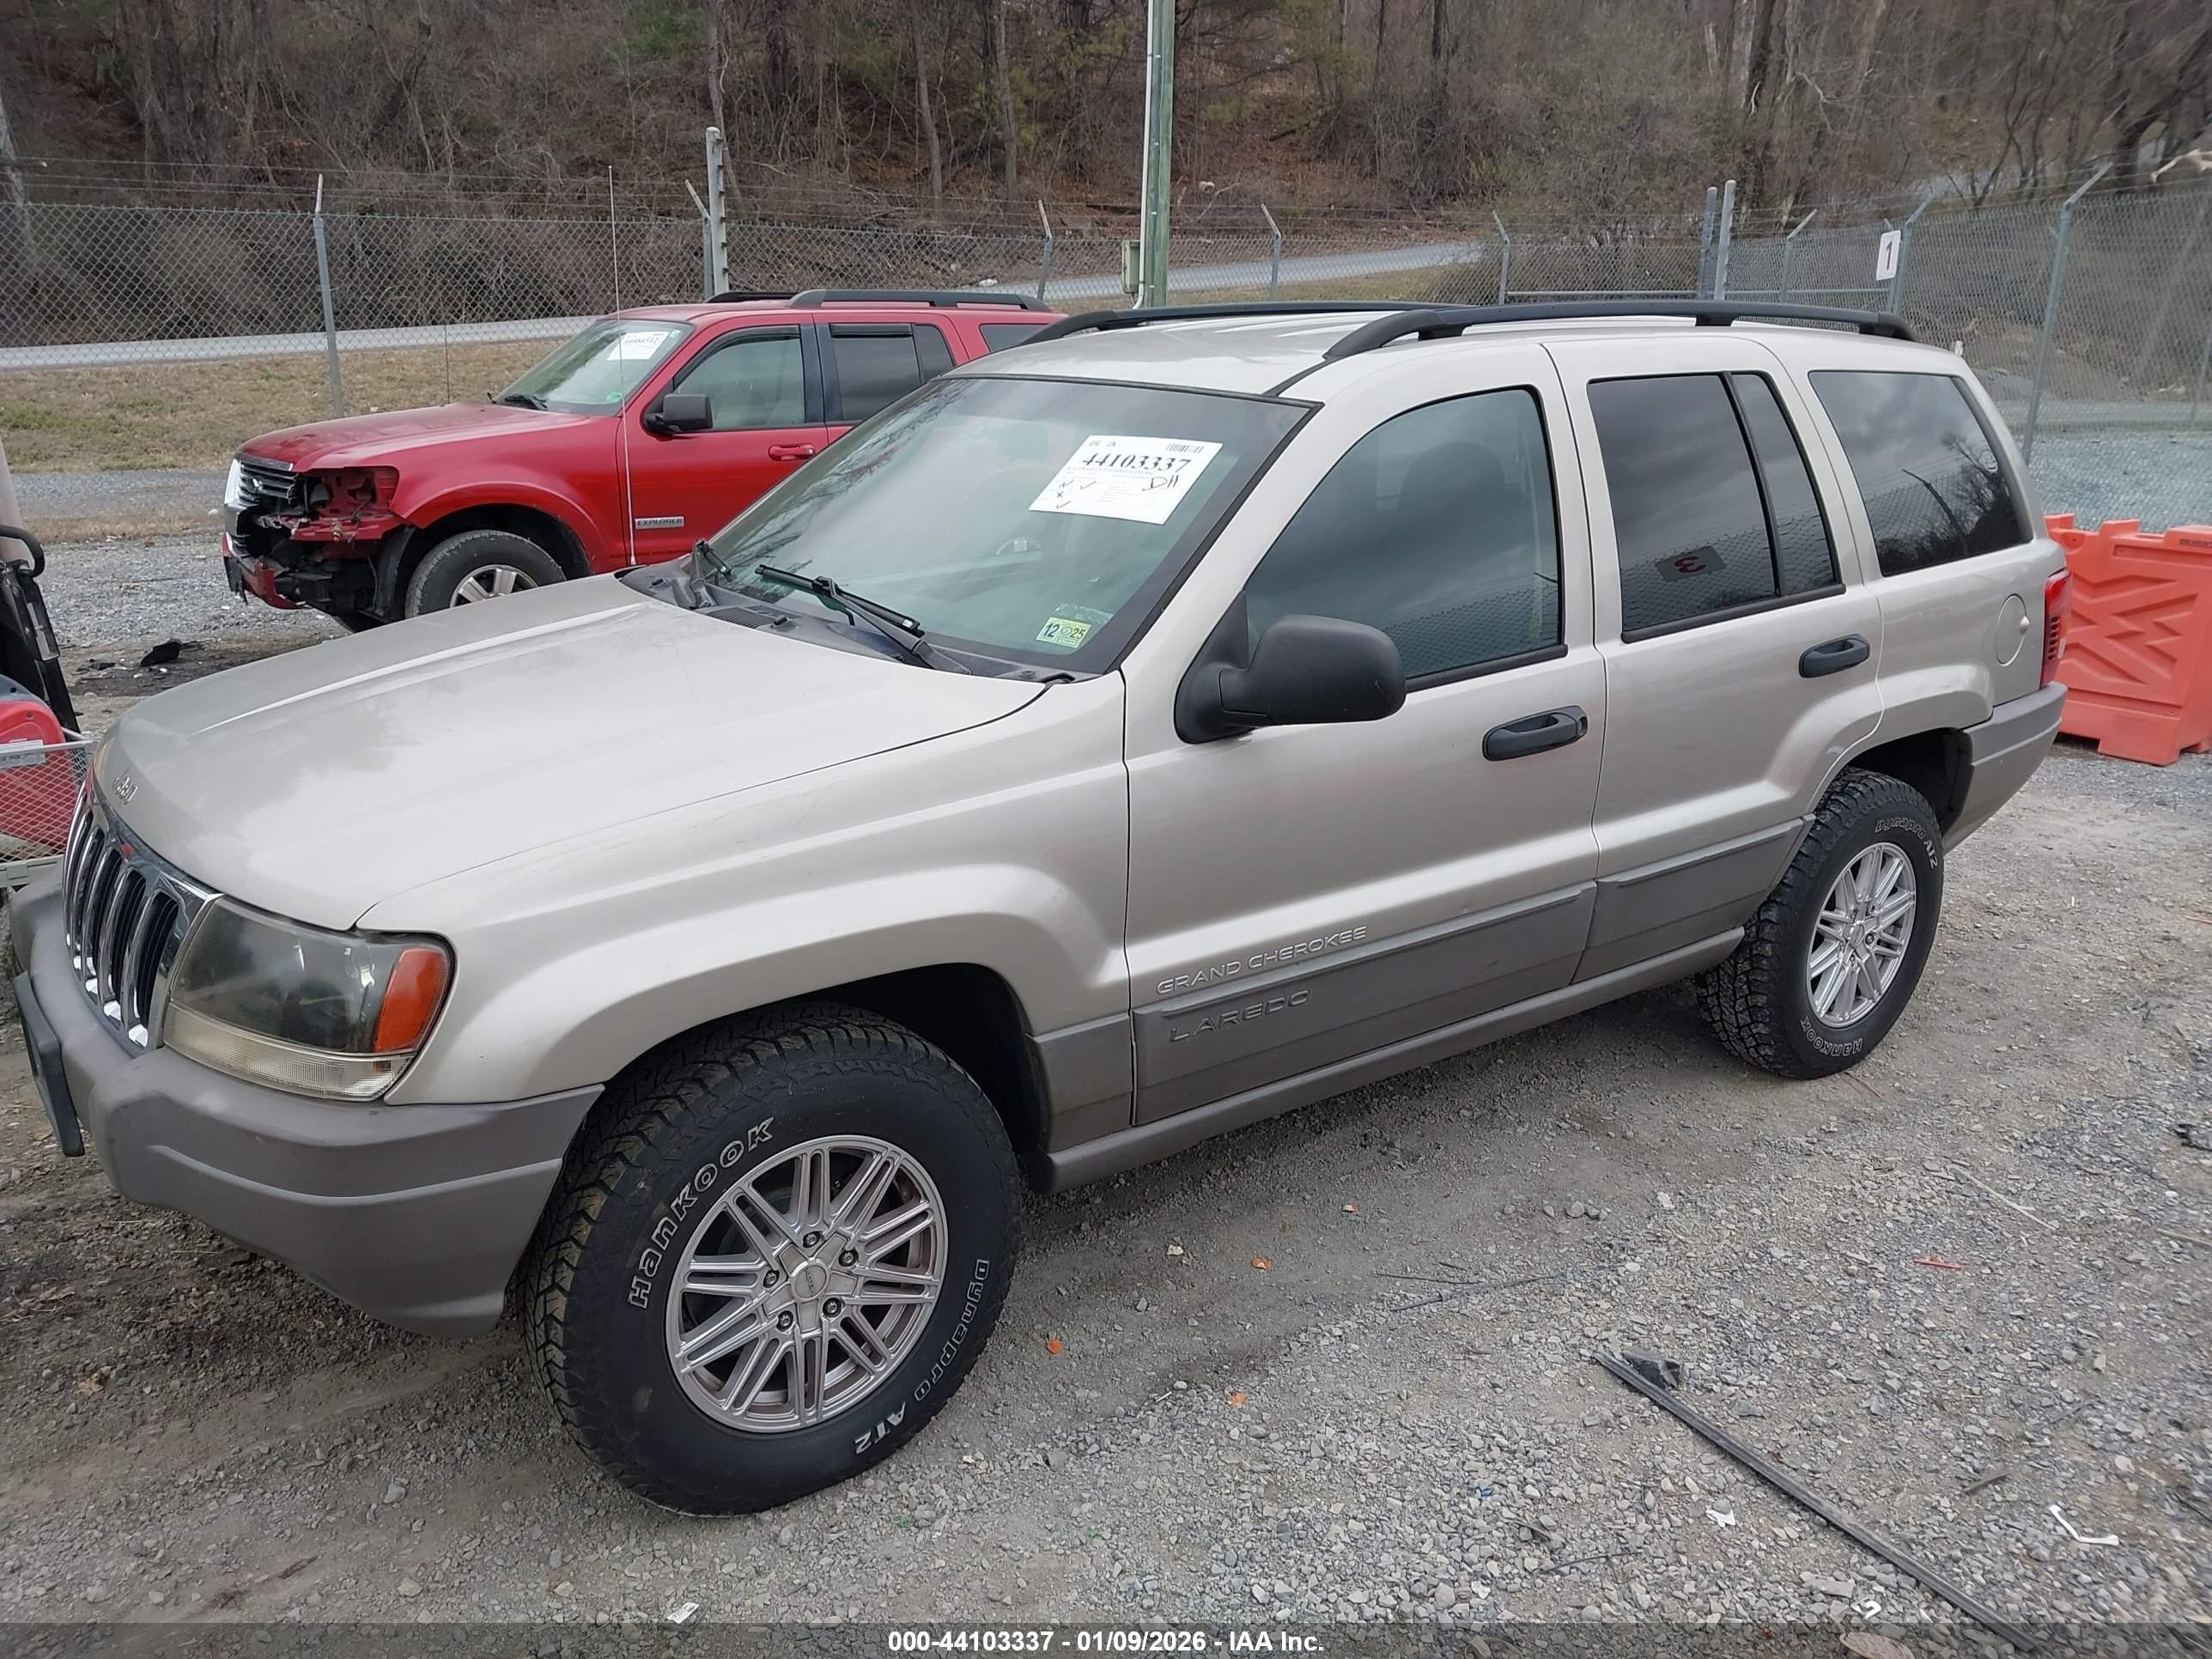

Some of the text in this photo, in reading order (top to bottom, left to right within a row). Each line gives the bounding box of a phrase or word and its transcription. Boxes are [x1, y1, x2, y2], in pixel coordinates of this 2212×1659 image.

[1886, 240, 1893, 270] 1
[1082, 453, 1192, 472] 44103337
[636, 517, 683, 526] EXPLORER
[1043, 623, 1060, 638] 12
[1070, 628, 1086, 640] 25
[1157, 925, 1368, 995] GRAND CHEROKEE
[1169, 988, 1311, 1042] LAREDO
